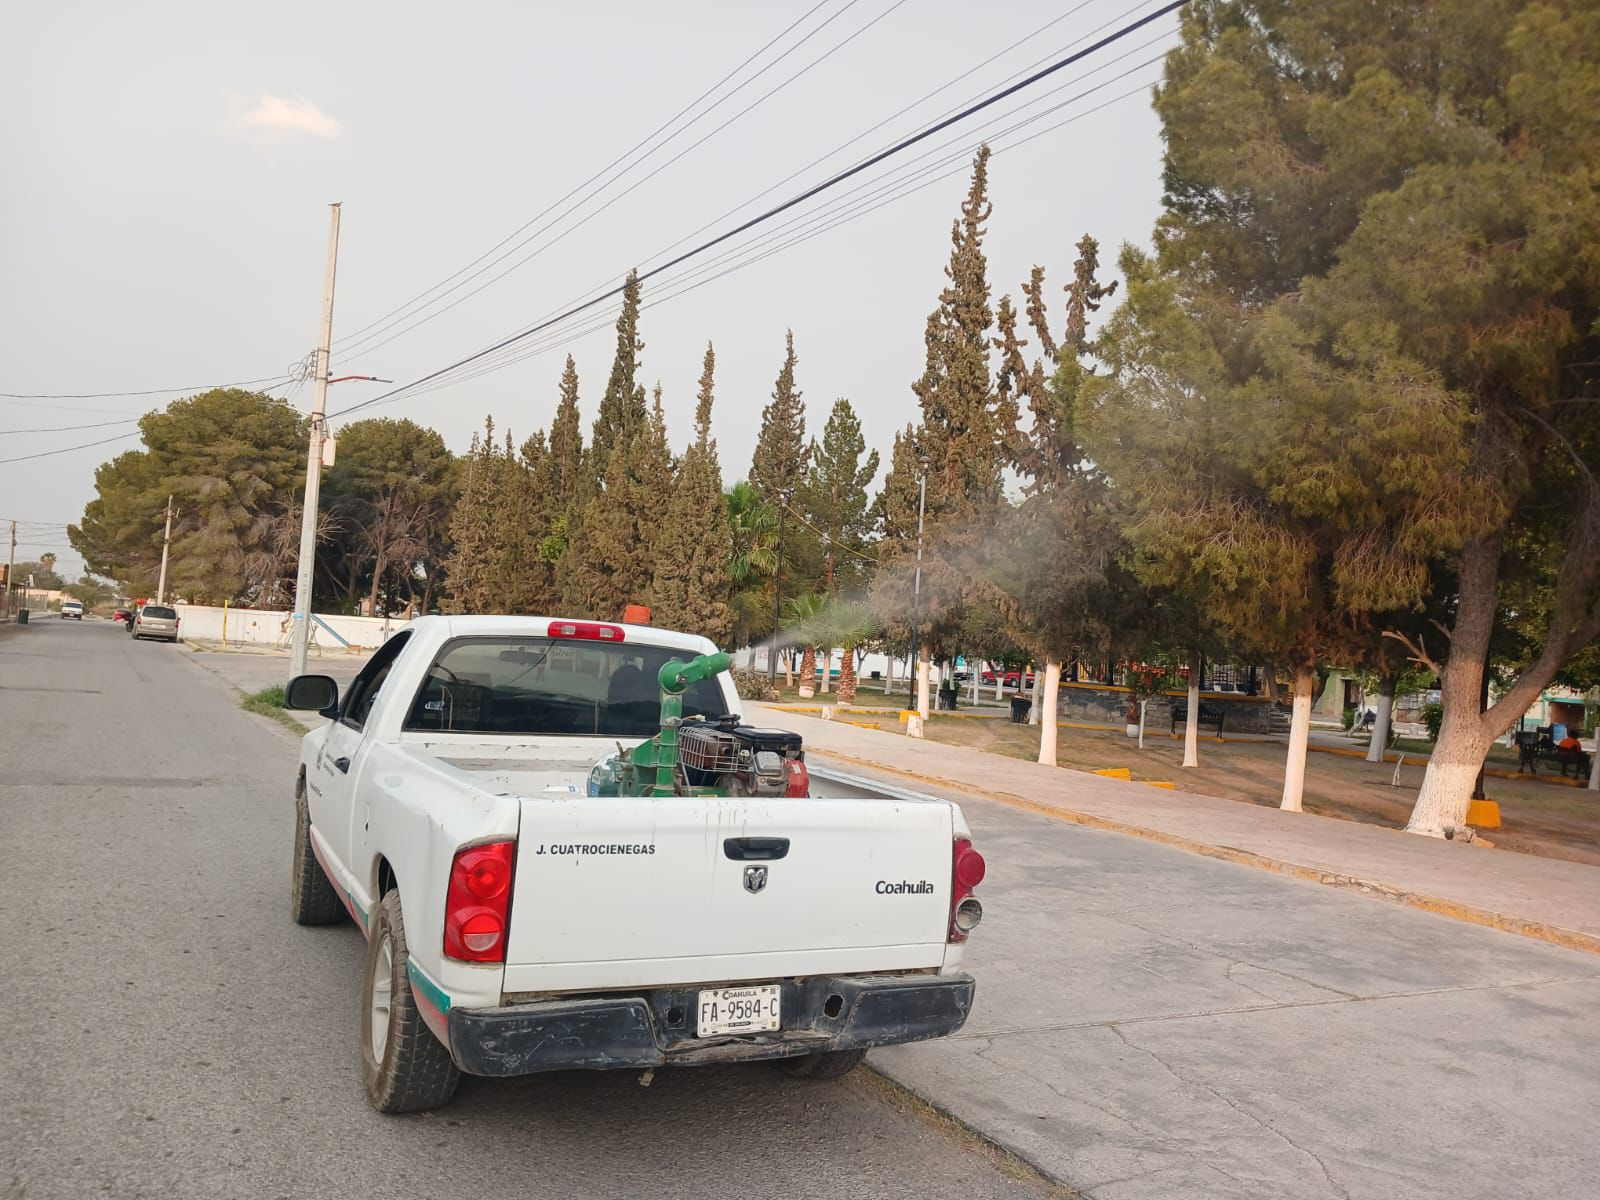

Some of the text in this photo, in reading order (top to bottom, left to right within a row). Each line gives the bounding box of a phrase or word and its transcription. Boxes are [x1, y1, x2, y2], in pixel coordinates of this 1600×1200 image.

[536, 844, 655, 855] J. CUATROCIENEGAS
[875, 879, 934, 894] Coahuila
[722, 990, 757, 1000] COAHUILA
[701, 998, 778, 1023] FA-9584-C
